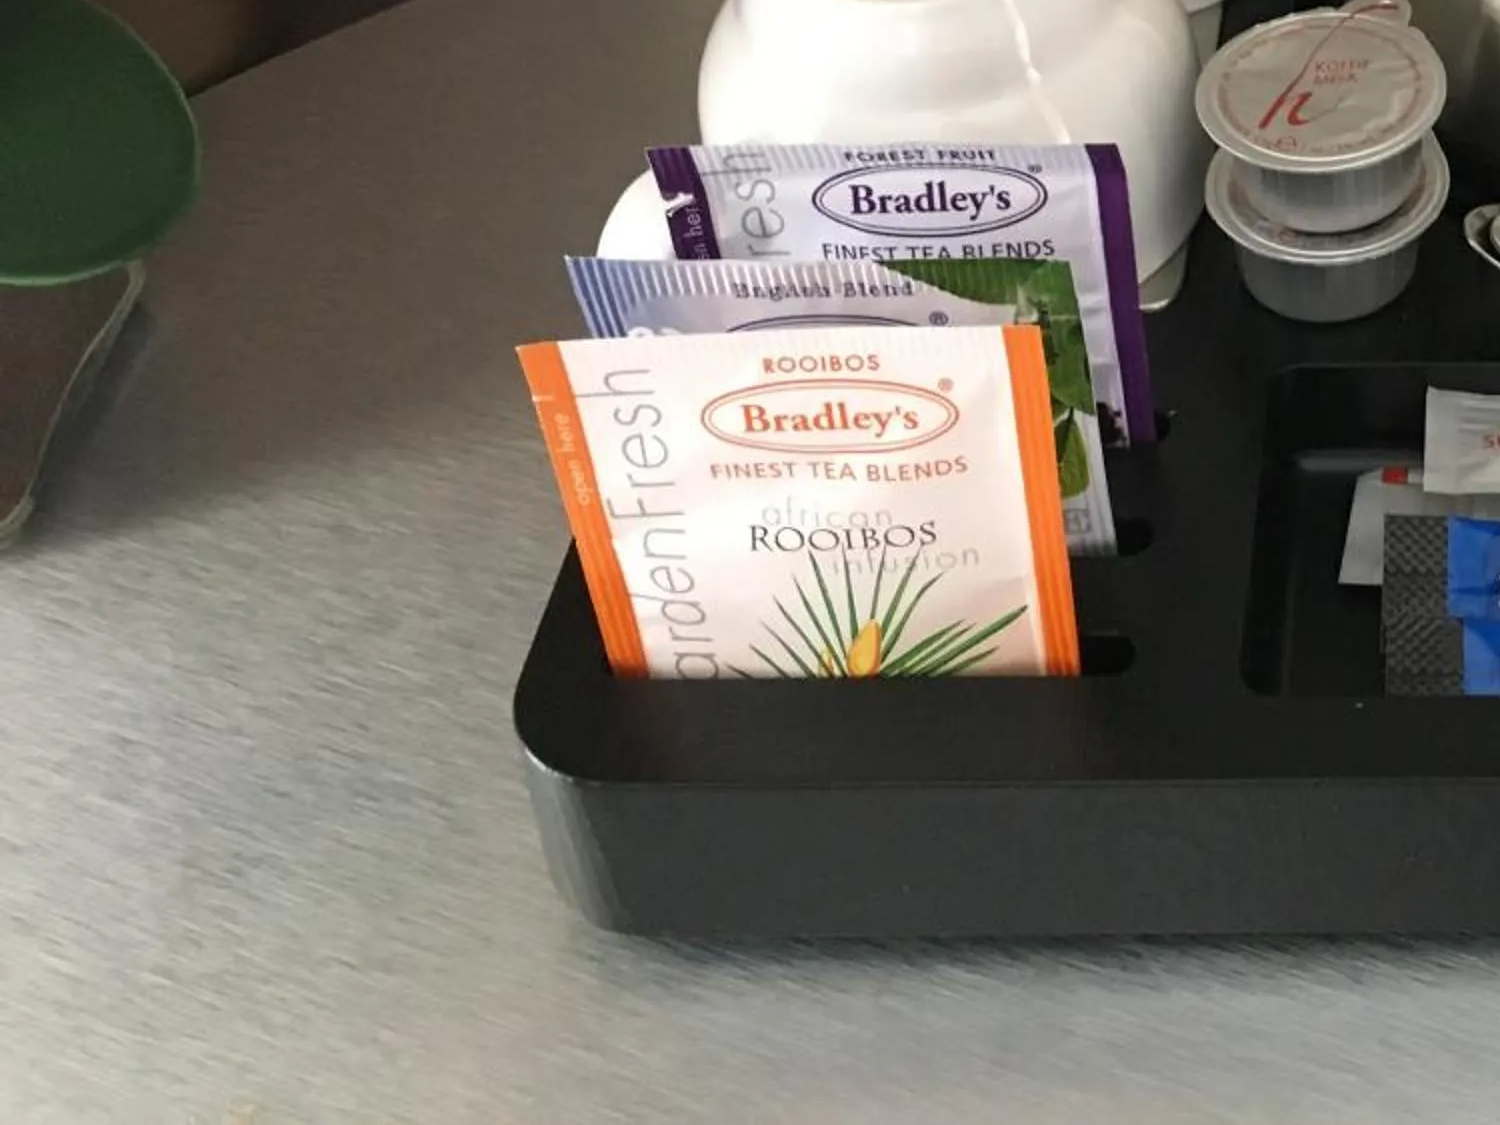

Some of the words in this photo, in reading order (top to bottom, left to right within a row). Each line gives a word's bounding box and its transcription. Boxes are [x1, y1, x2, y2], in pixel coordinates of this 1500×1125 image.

[844, 149, 925, 162] FOREST
[937, 149, 996, 161] FRUIT
[848, 180, 1012, 220] Bradley's
[843, 281, 914, 298] Blend
[762, 354, 881, 374] ROOIBOS
[740, 401, 920, 439] Bradley's
[709, 460, 798, 480] FINEST
[807, 461, 859, 481] TEA
[866, 455, 970, 482] BLENDS
[574, 369, 723, 680] ardenFresh
[750, 520, 938, 552] ROOIBOS
